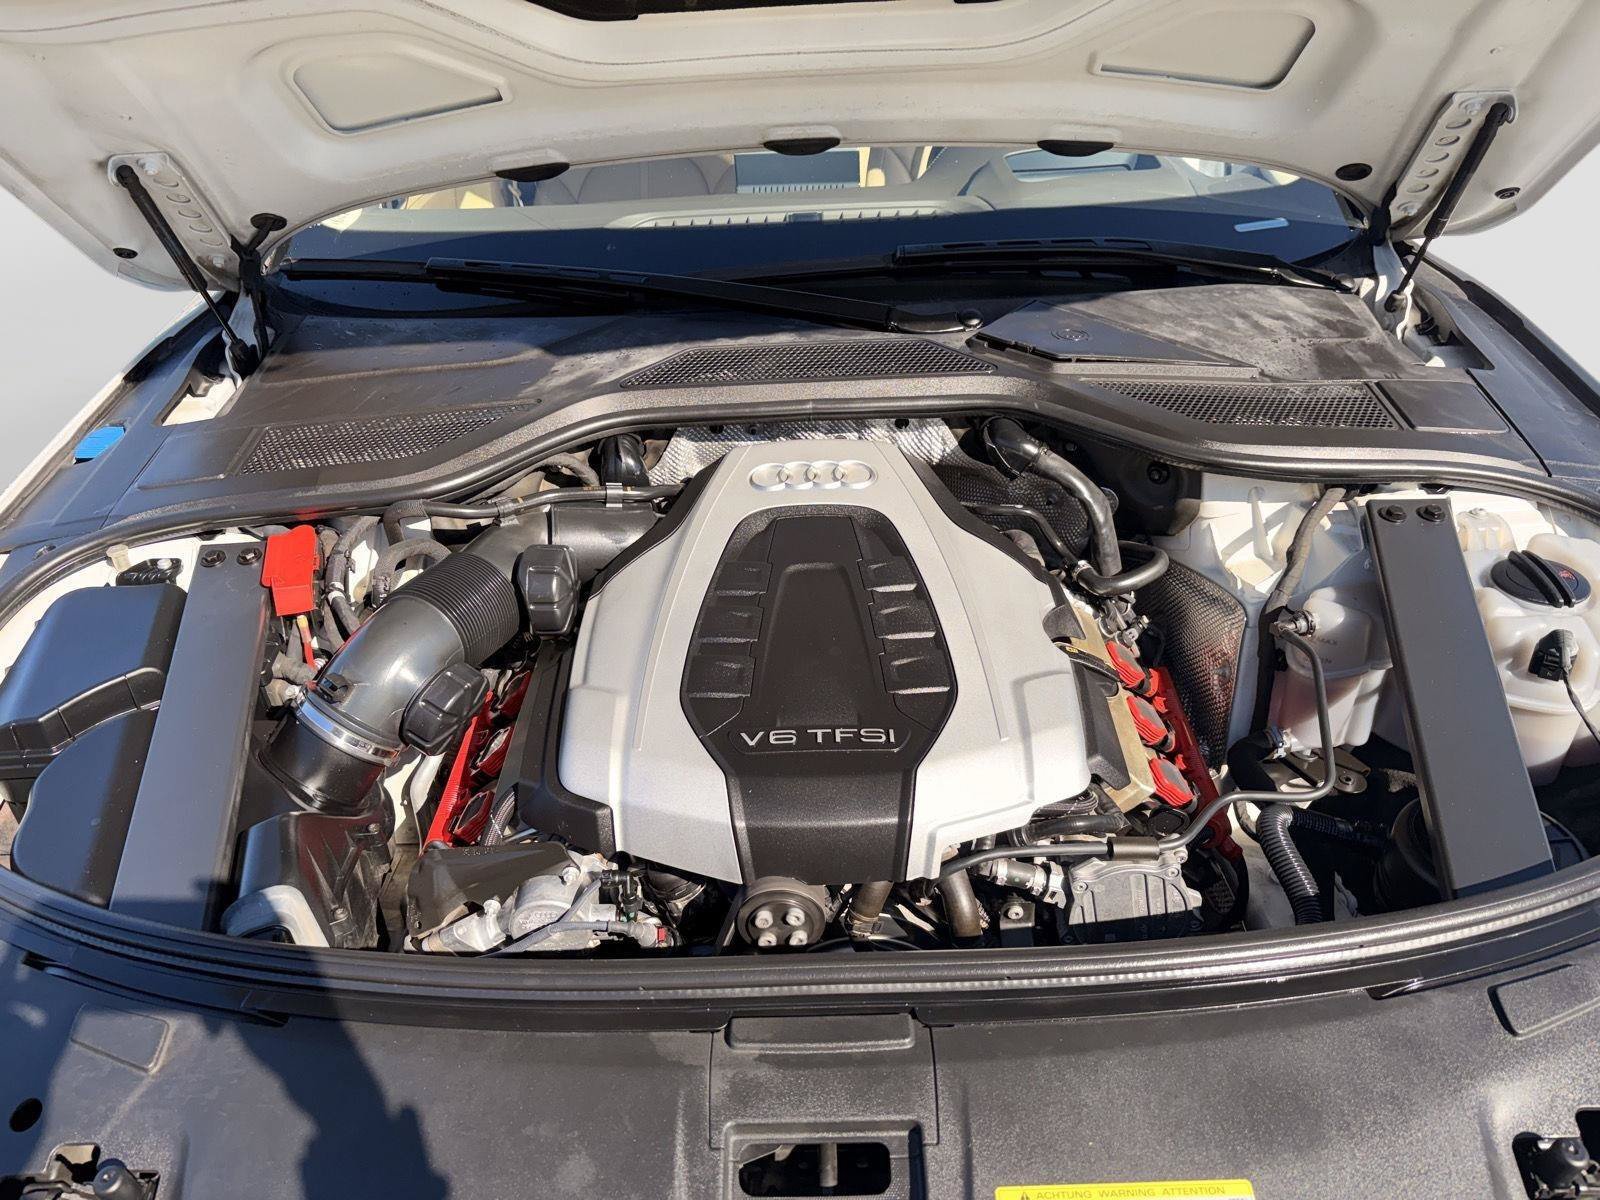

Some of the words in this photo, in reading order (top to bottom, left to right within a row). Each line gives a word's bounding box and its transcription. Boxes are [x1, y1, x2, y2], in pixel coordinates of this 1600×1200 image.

[740, 729, 797, 746] V6
[807, 728, 895, 743] TFSI
[1036, 1190, 1092, 1200] ACHTUNG
[1098, 1188, 1156, 1198] WARNING
[1162, 1186, 1226, 1196] ATTENTION
